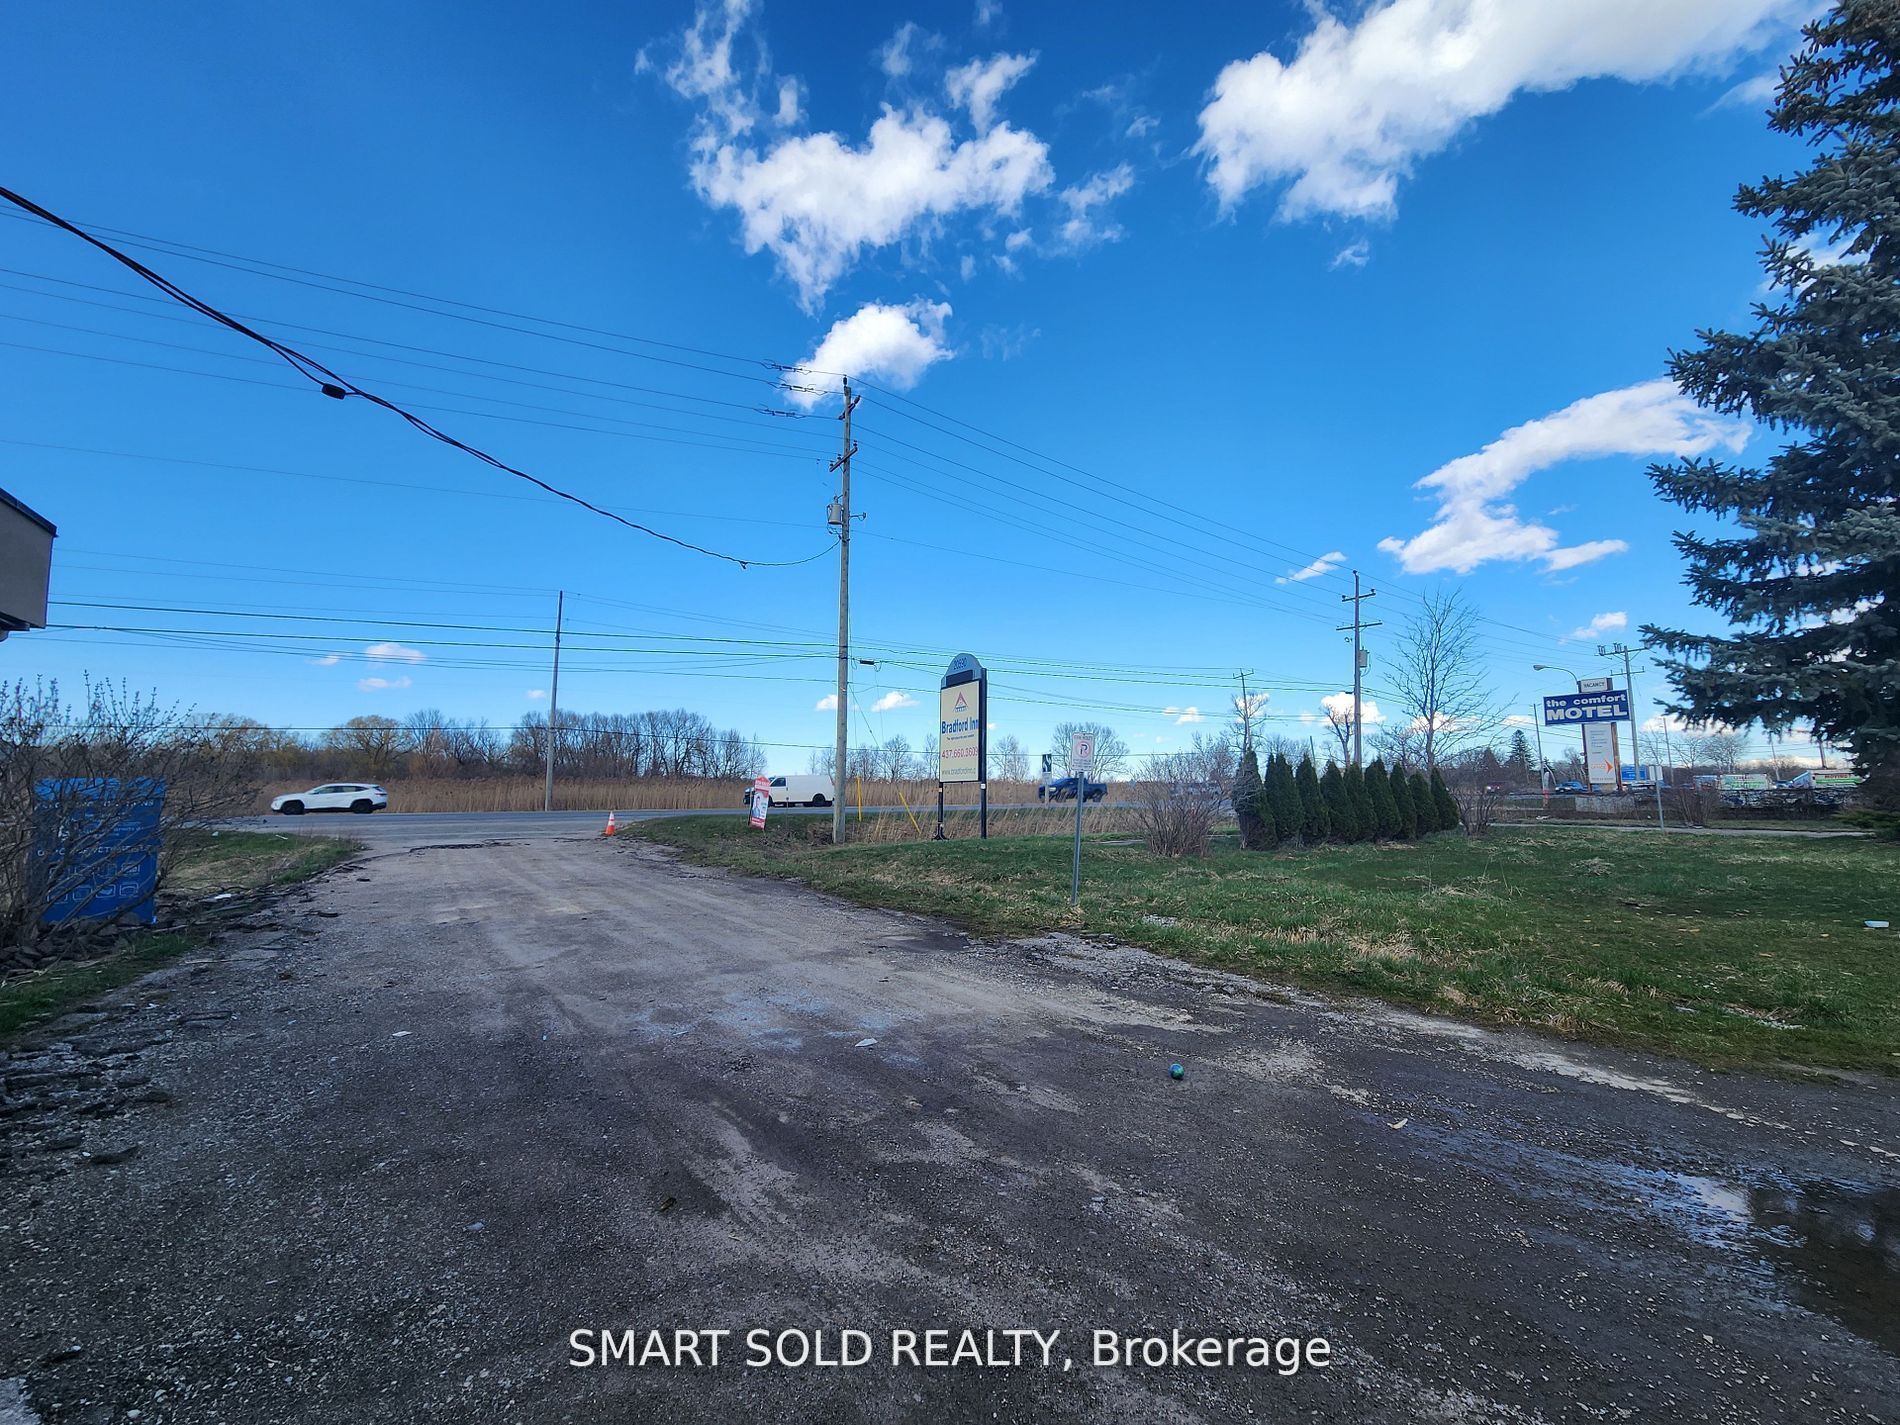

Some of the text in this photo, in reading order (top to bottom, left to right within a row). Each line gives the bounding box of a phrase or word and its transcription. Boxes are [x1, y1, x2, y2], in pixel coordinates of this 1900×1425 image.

[1546, 694, 1626, 707] the comfort
[1546, 704, 1628, 721] MOTEL
[941, 717, 969, 734] Bradford
